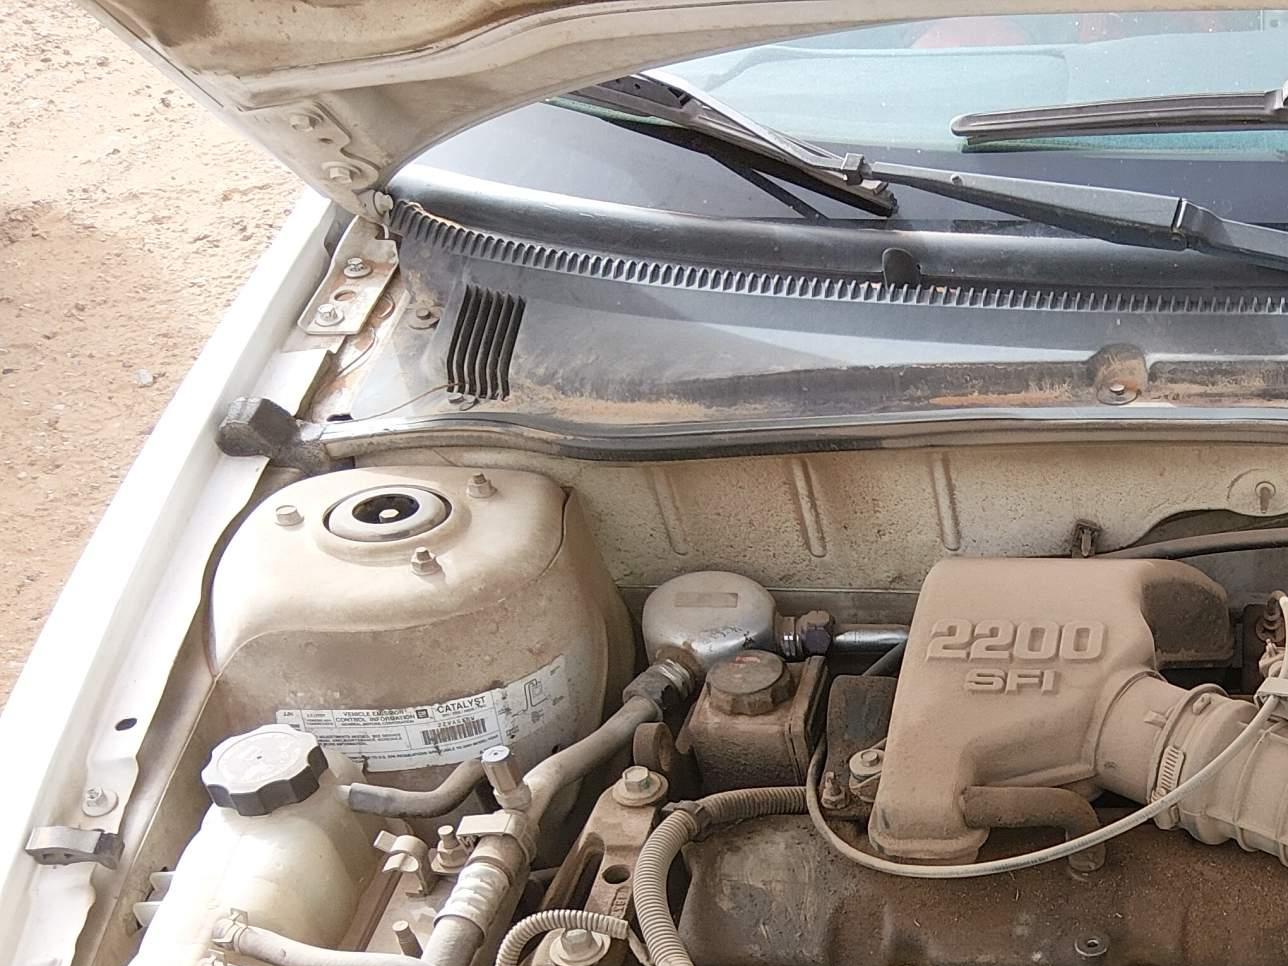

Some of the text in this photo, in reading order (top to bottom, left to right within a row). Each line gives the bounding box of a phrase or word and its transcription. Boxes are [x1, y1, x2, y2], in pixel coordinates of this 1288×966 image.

[926, 618, 1106, 662] 2200
[965, 668, 1058, 694] SFI
[437, 696, 486, 713] CATALYST
